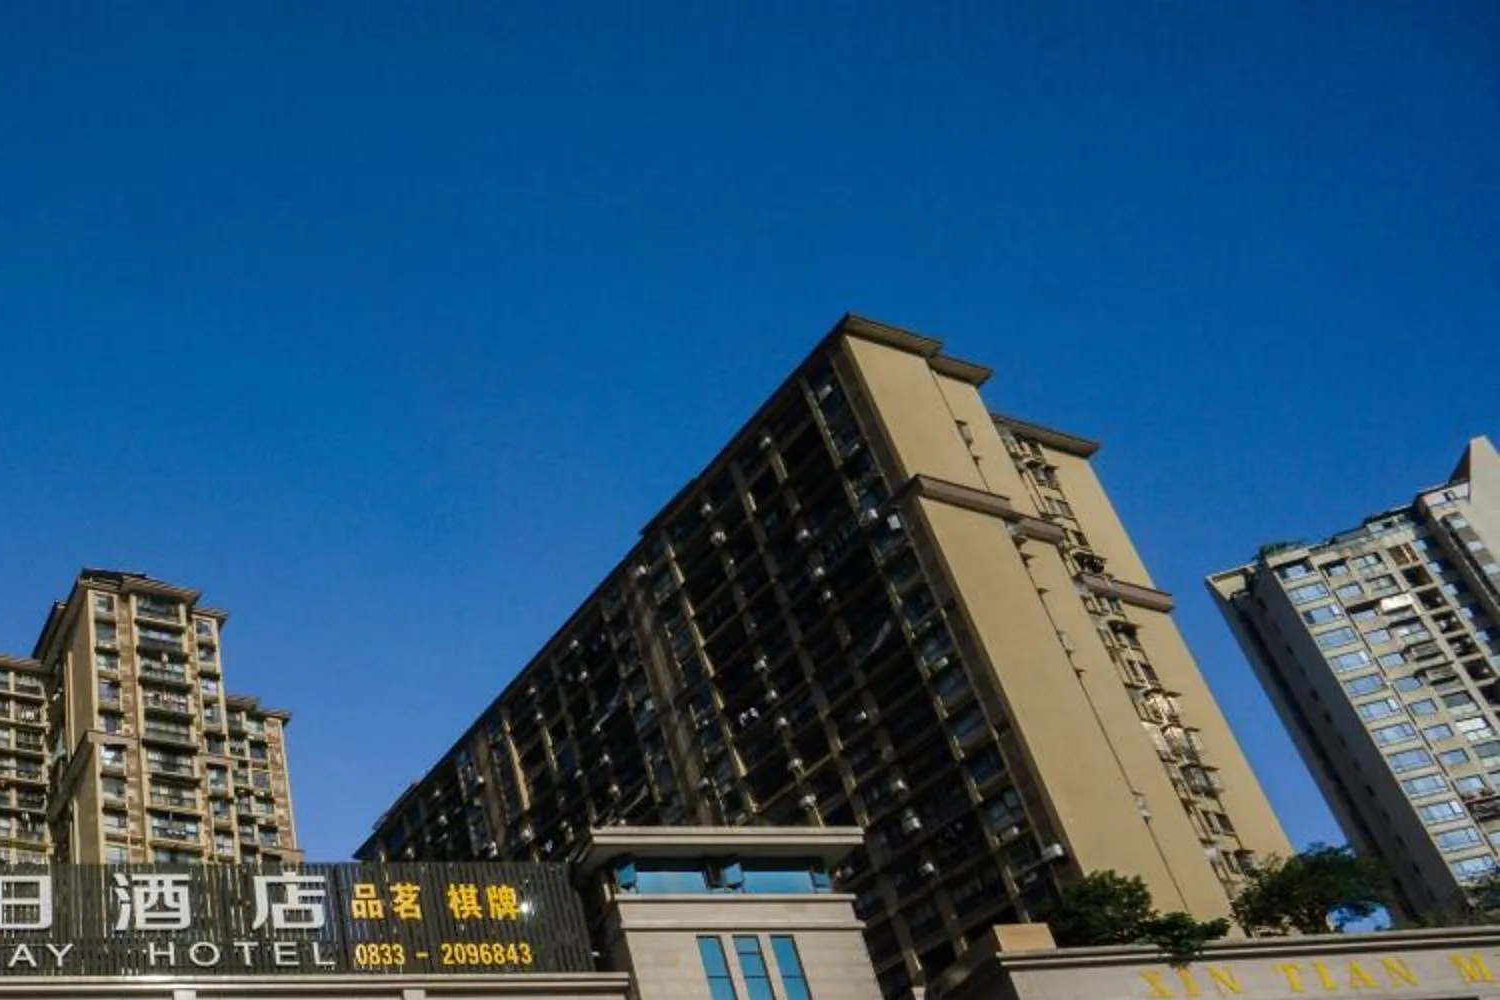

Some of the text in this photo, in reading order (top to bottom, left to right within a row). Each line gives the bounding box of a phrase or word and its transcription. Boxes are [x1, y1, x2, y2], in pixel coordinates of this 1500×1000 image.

[352, 882, 519, 920] 品茗 棋牌
[147, 941, 337, 968] HOTEL
[355, 943, 405, 966] 0833
[441, 942, 533, 966] 2096843
